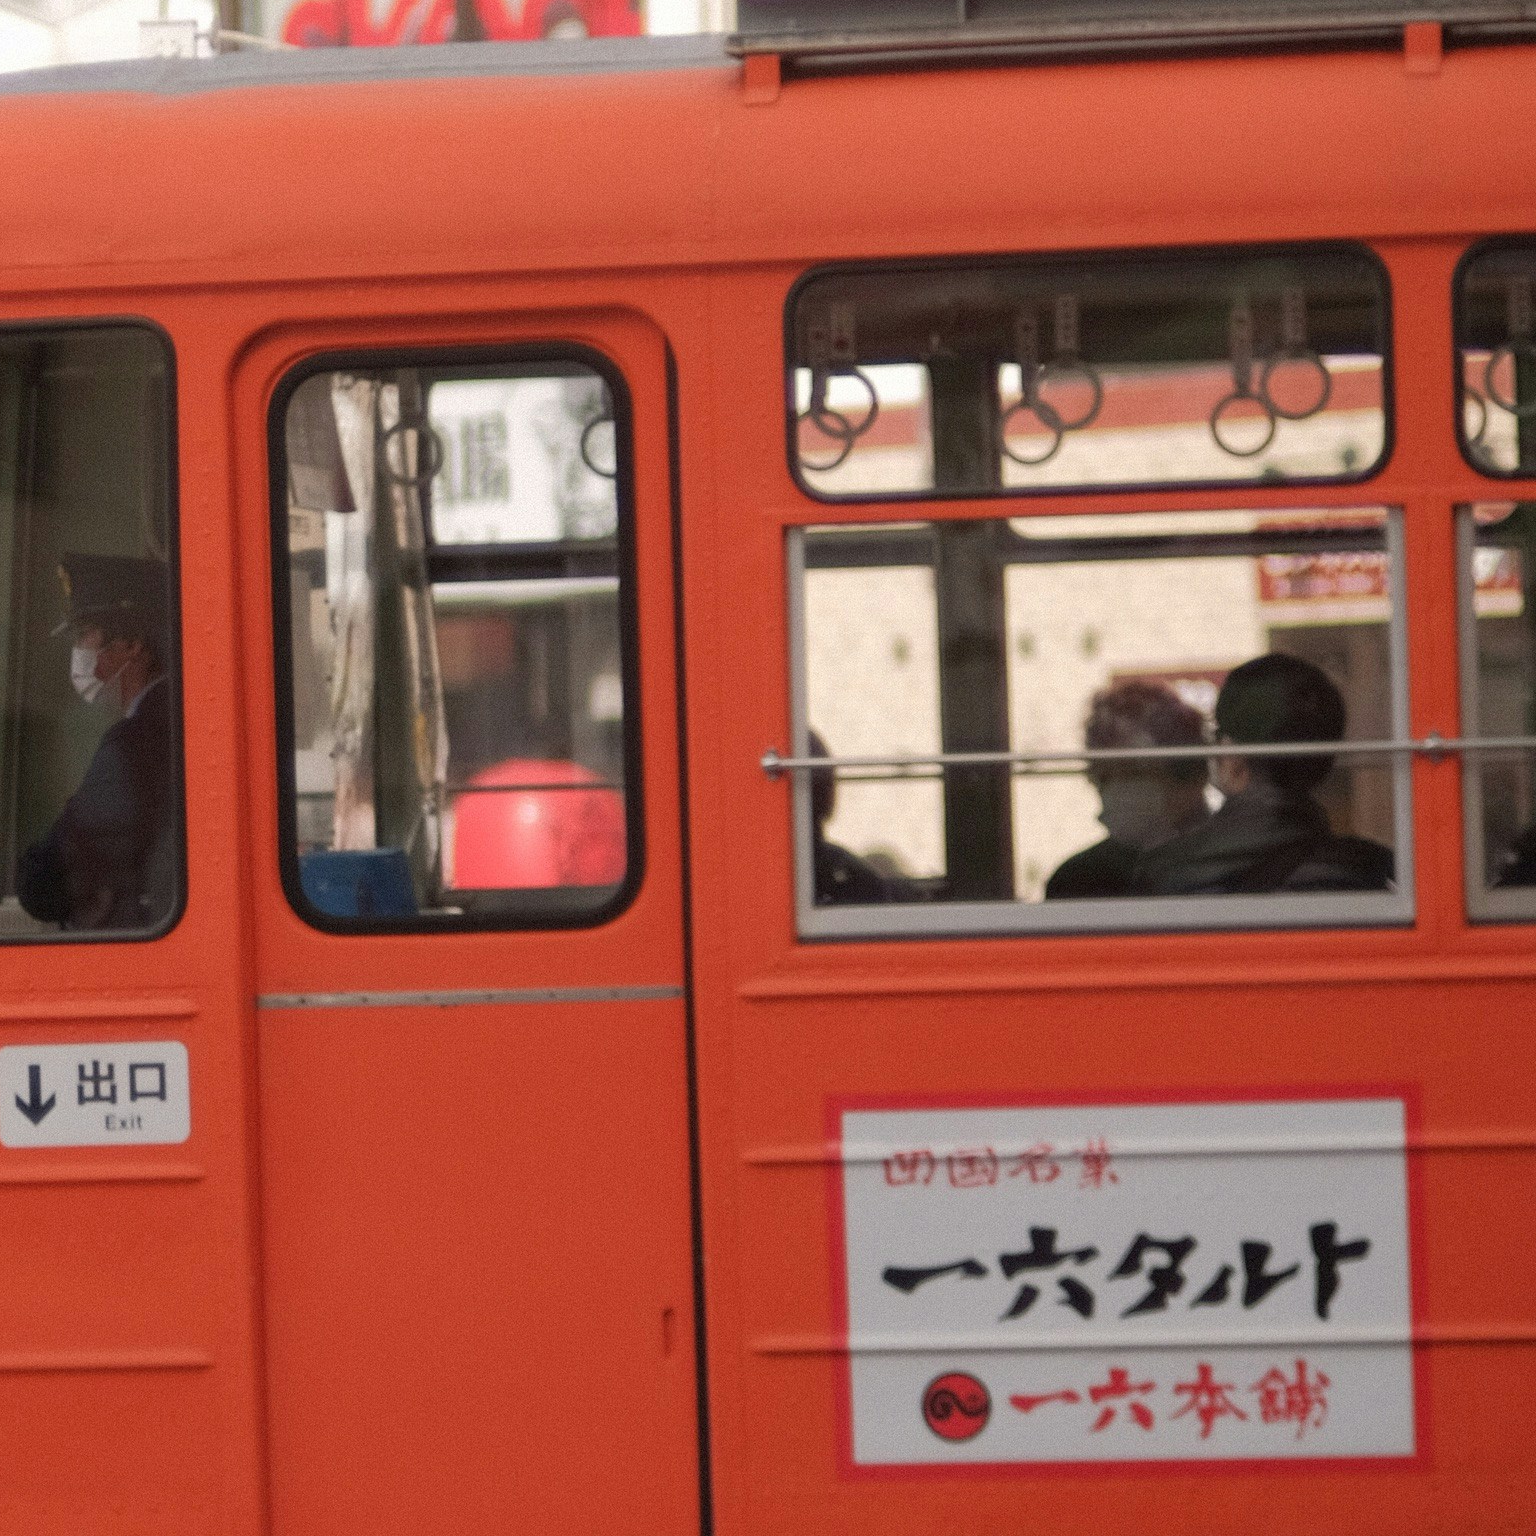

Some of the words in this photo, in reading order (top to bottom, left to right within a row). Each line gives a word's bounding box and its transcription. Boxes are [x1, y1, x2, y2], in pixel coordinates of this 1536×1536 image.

[76, 1060, 167, 1106] 出口
[104, 1114, 143, 1132] Exit
[881, 1221, 1372, 1323] 一六タルト
